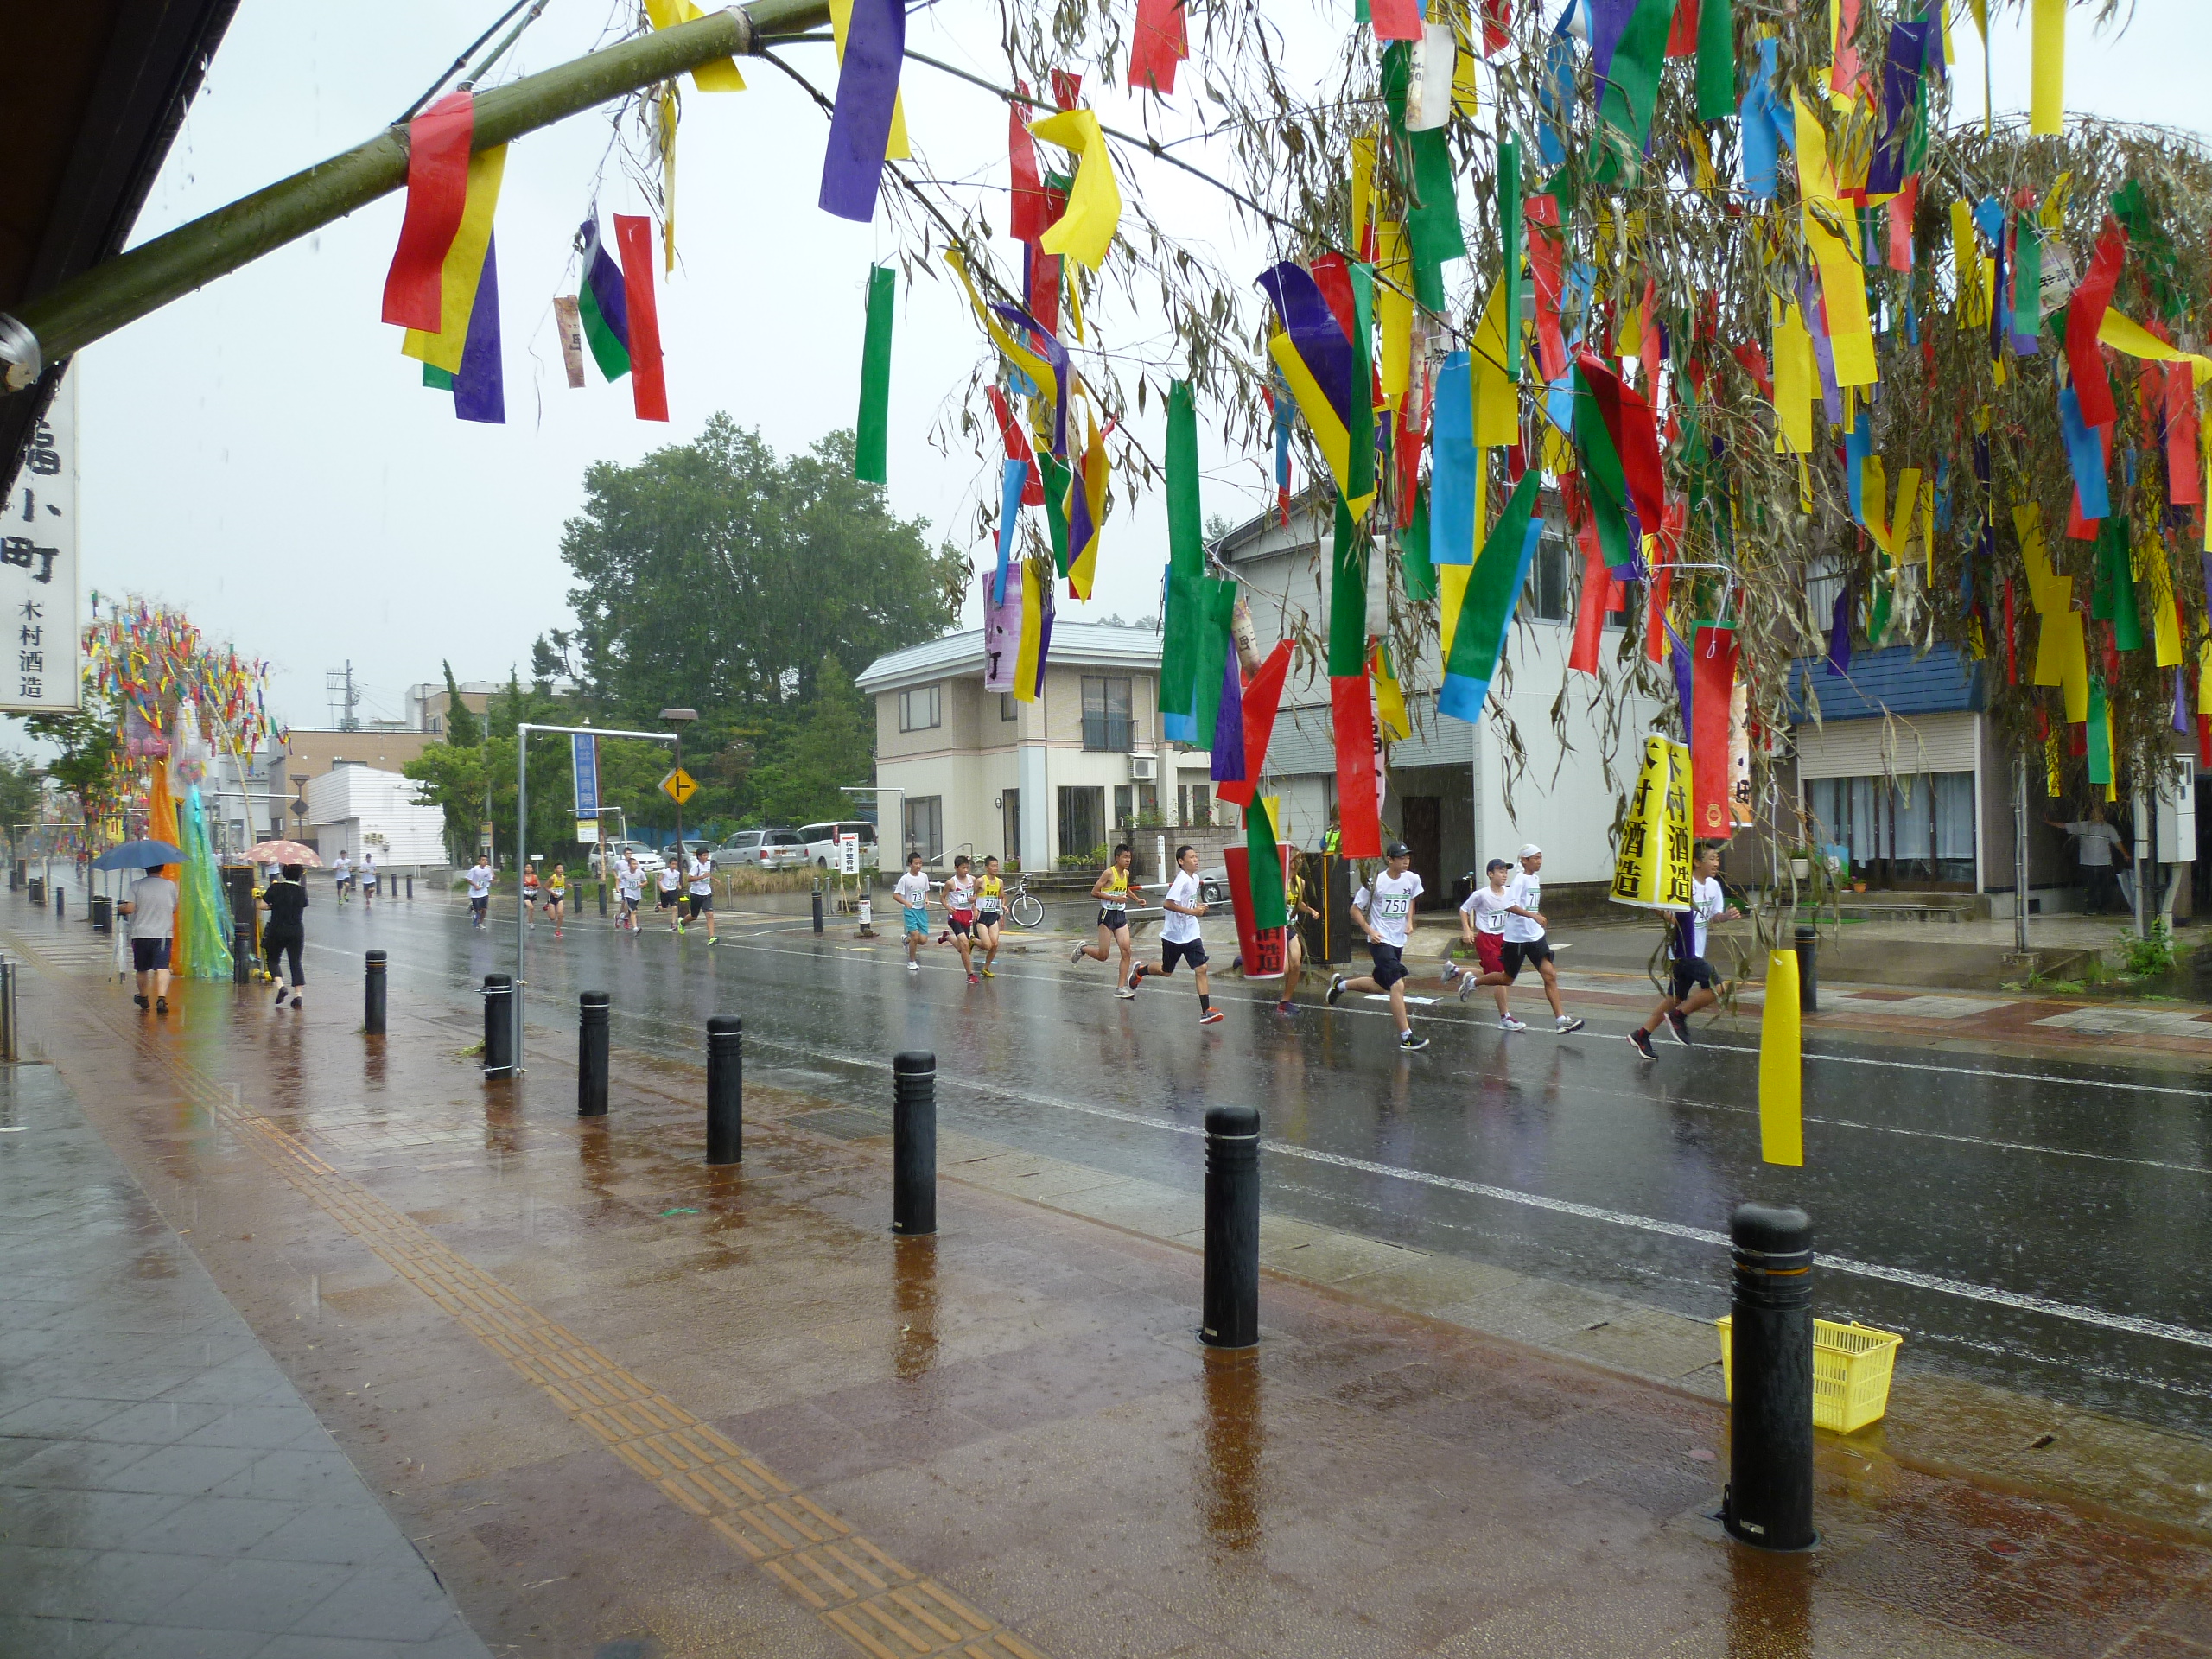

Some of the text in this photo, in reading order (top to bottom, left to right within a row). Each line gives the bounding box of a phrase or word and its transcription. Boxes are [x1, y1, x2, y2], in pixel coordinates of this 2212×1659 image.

[18, 599, 44, 699] 木村酒造
[1385, 899, 1407, 912] 750
